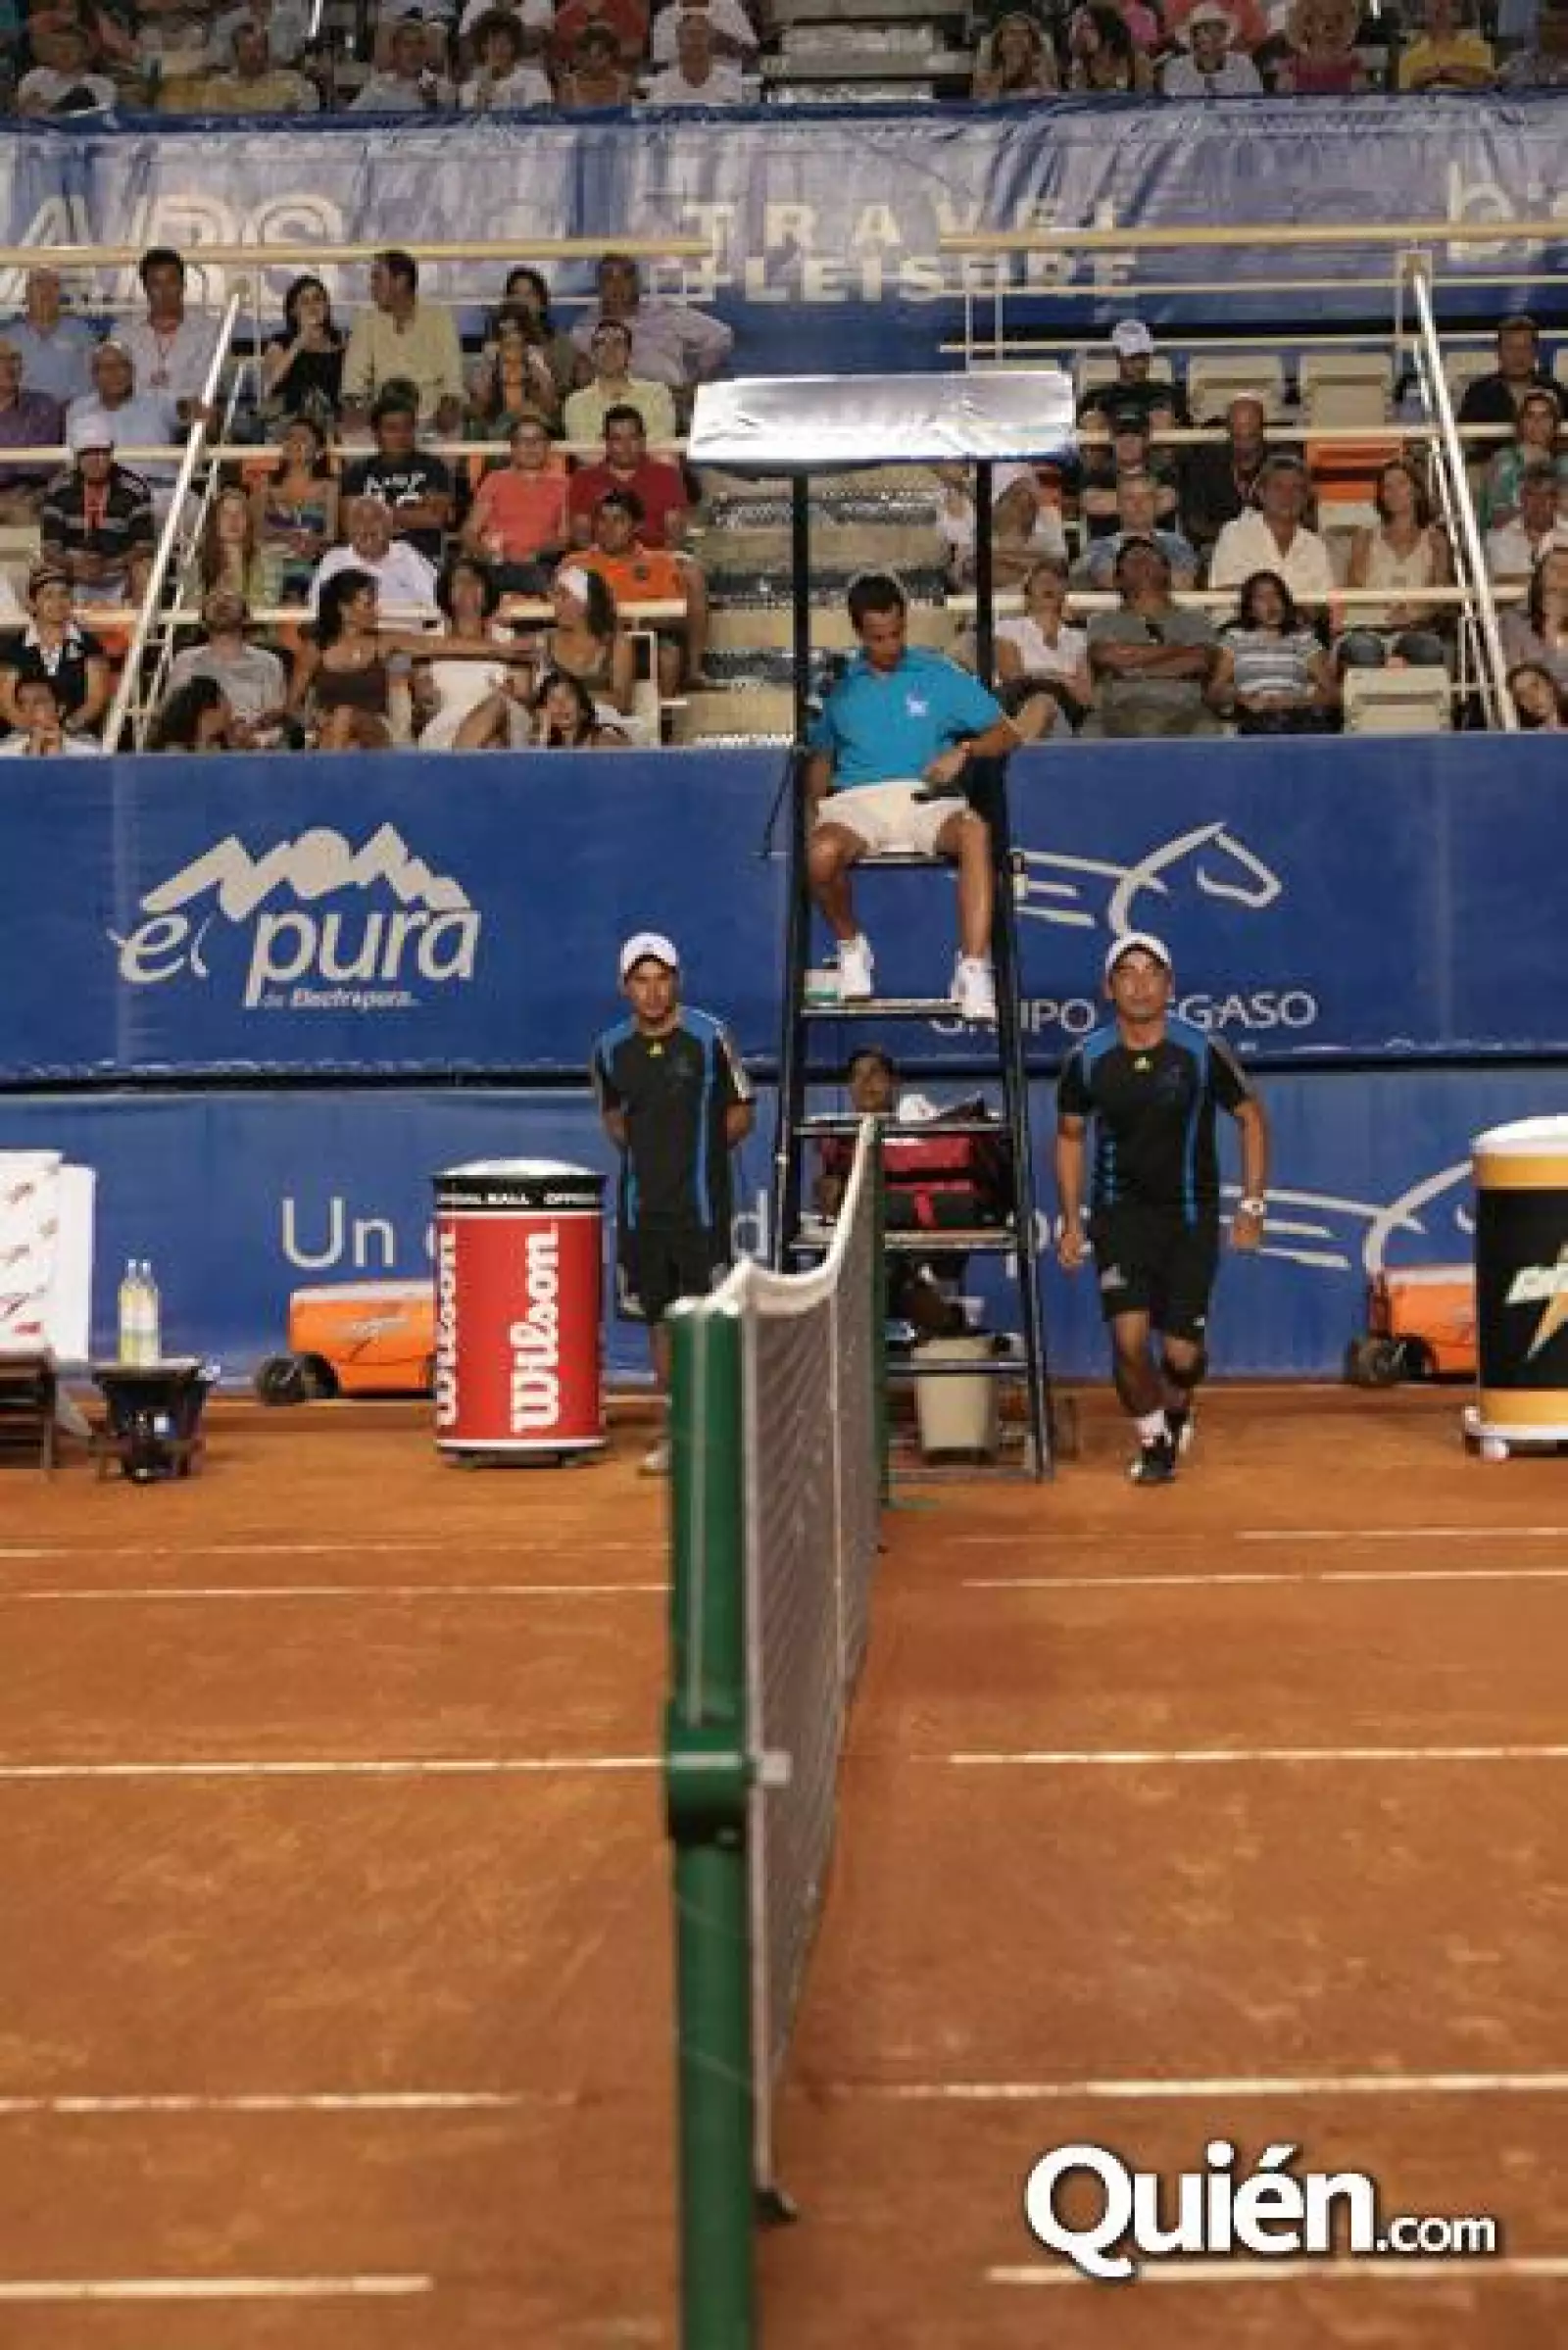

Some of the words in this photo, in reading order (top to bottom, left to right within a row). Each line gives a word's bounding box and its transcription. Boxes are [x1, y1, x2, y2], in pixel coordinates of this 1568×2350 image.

[243, 911, 482, 1008] pura
[1164, 990, 1315, 1031] GASO
[281, 1196, 396, 1269] Un
[509, 1221, 560, 1434] Wilson
